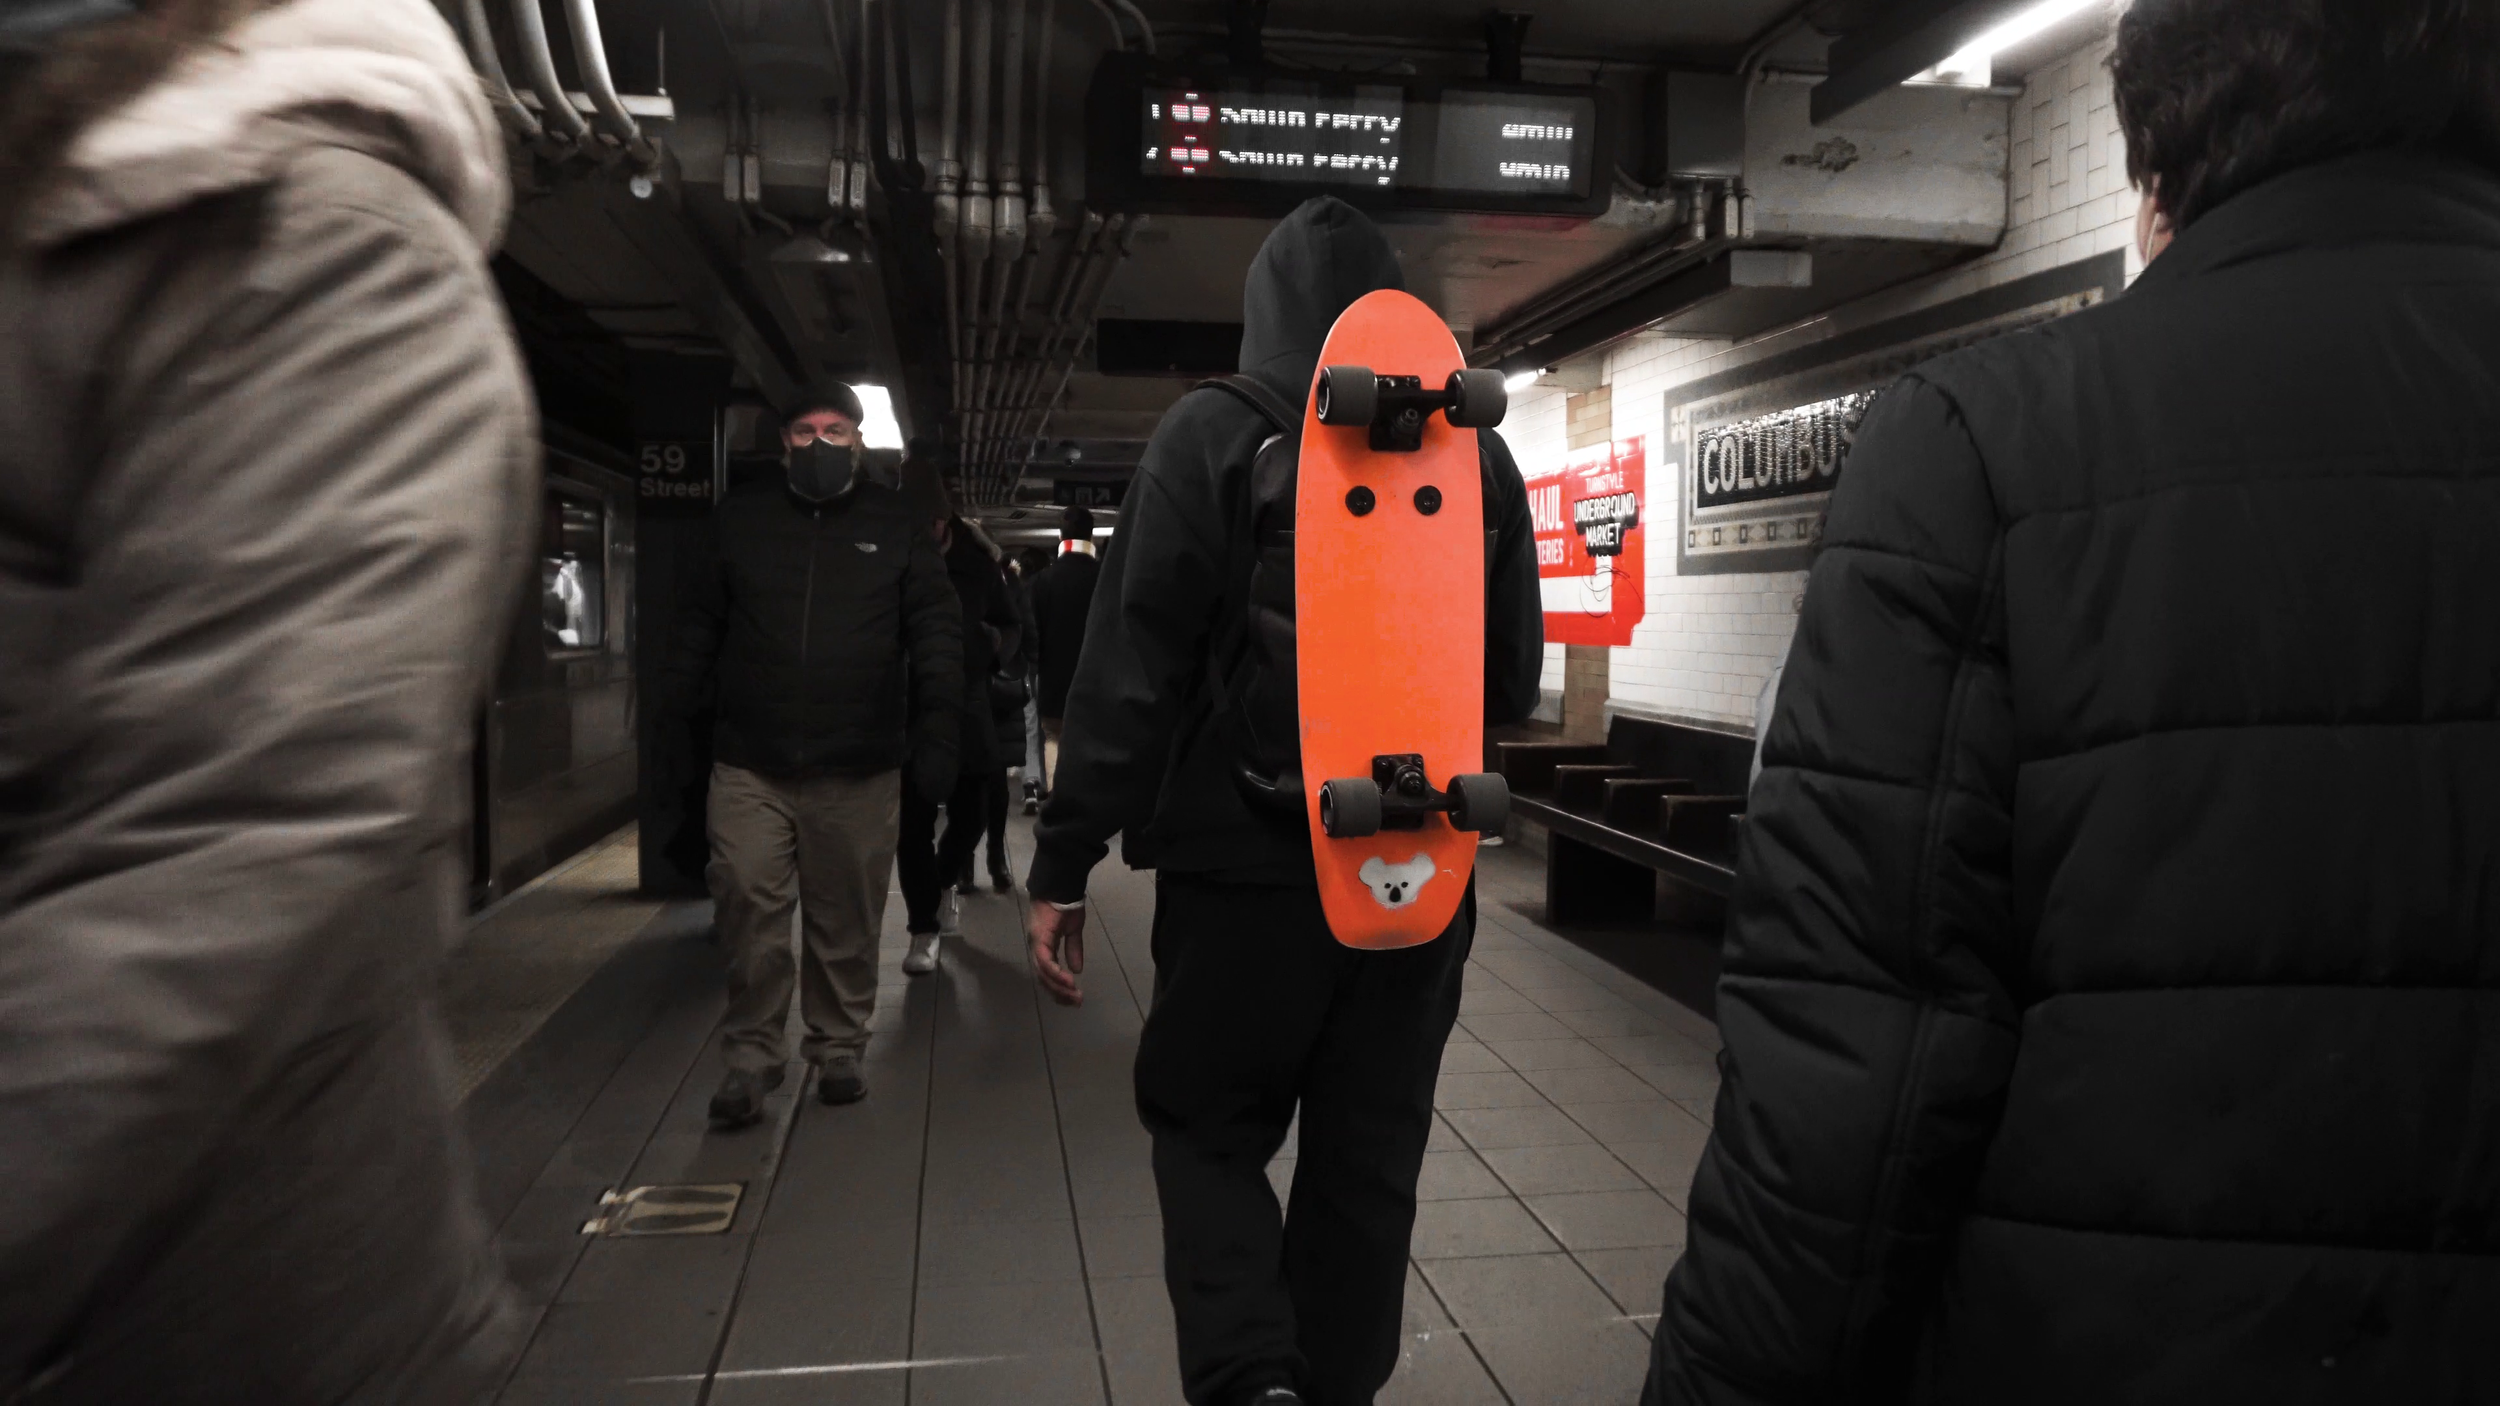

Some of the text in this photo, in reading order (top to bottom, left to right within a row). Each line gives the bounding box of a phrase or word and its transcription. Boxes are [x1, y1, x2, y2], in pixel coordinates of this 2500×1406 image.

[640, 444, 686, 474] 59
[640, 477, 711, 498] Street
[1585, 471, 1624, 493] TURNSTYLE
[1574, 492, 1635, 522] UNDERGROUND
[1585, 523, 1621, 547] MARKET
[1536, 538, 1564, 565] TERIES
